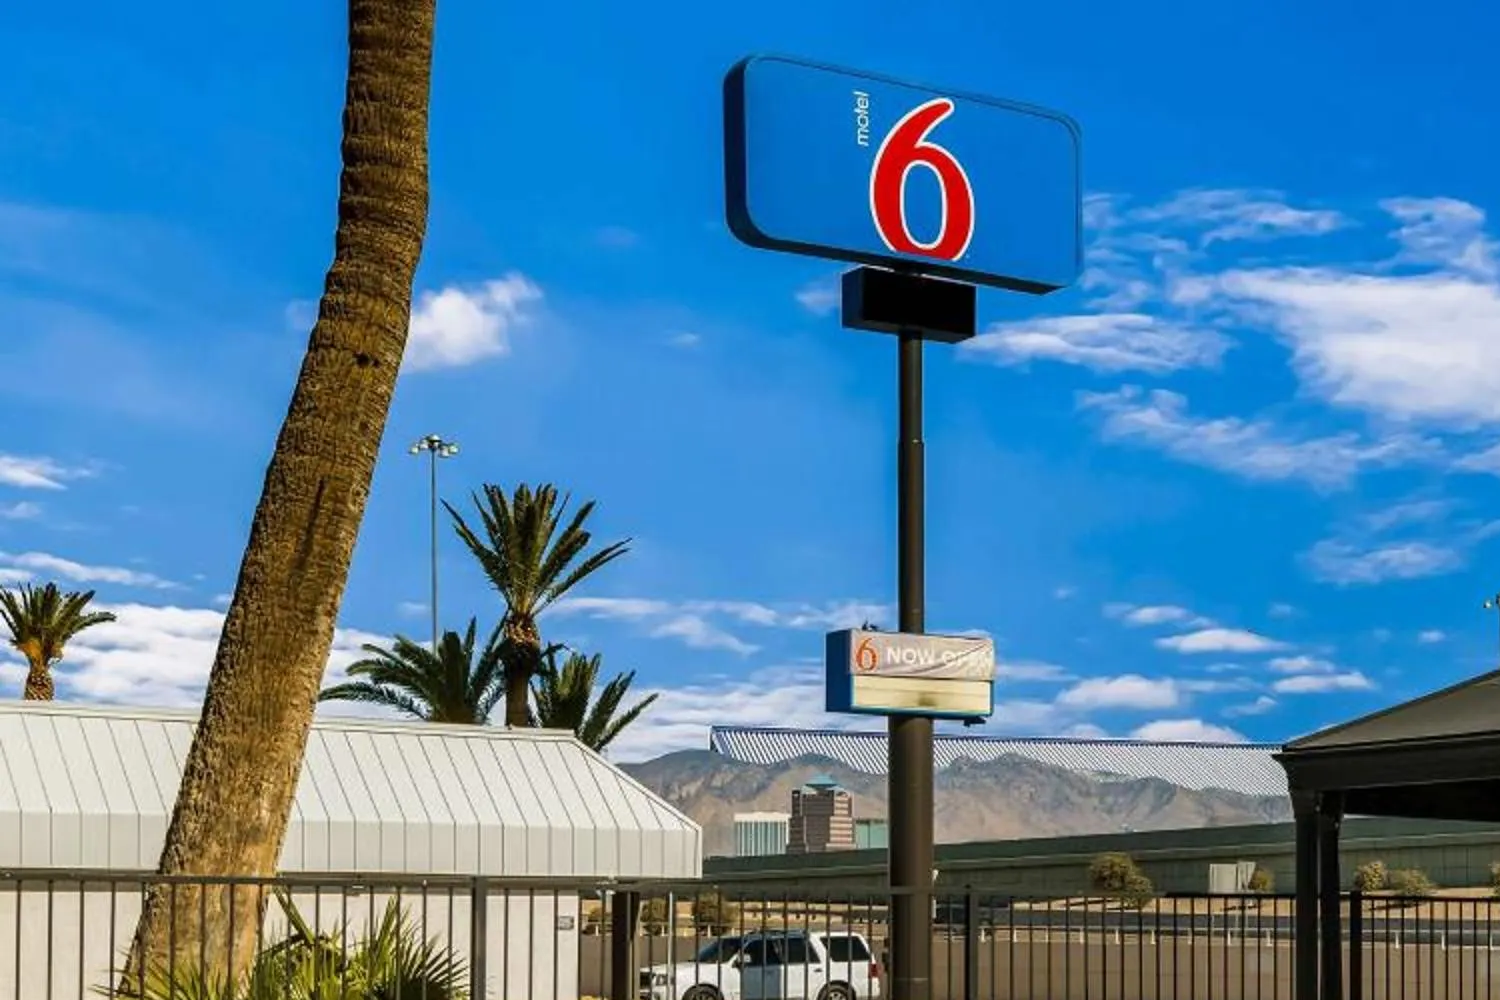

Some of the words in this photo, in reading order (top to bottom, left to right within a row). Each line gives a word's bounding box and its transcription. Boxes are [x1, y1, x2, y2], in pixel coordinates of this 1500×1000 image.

[852, 91, 870, 147] motel
[869, 97, 976, 262] 6
[855, 636, 879, 673] 6
[886, 646, 936, 666] NOW
